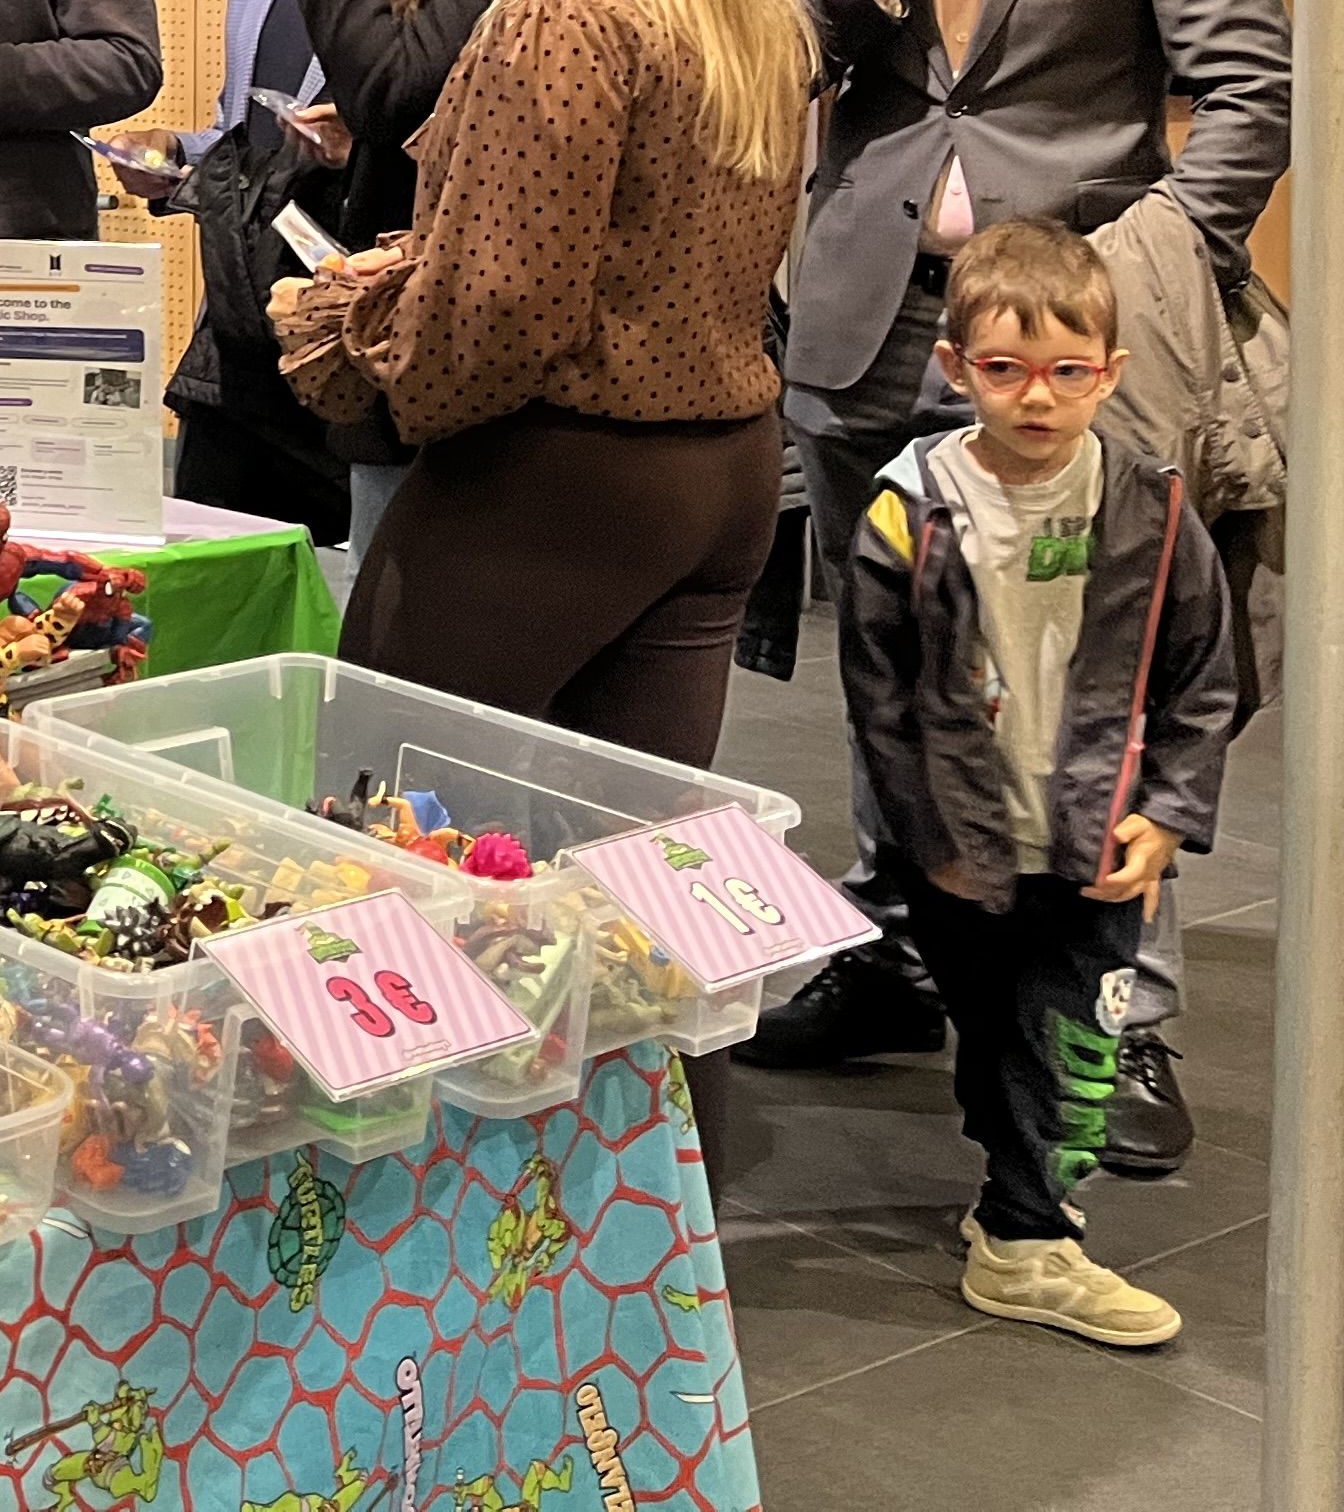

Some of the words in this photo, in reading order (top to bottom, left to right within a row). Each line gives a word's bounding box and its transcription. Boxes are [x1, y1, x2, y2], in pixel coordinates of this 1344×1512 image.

[34, 299, 47, 309] to
[50, 299, 72, 310] the
[13, 310, 50, 323] Shop.
[288, 1151, 324, 1314] TURTLES
